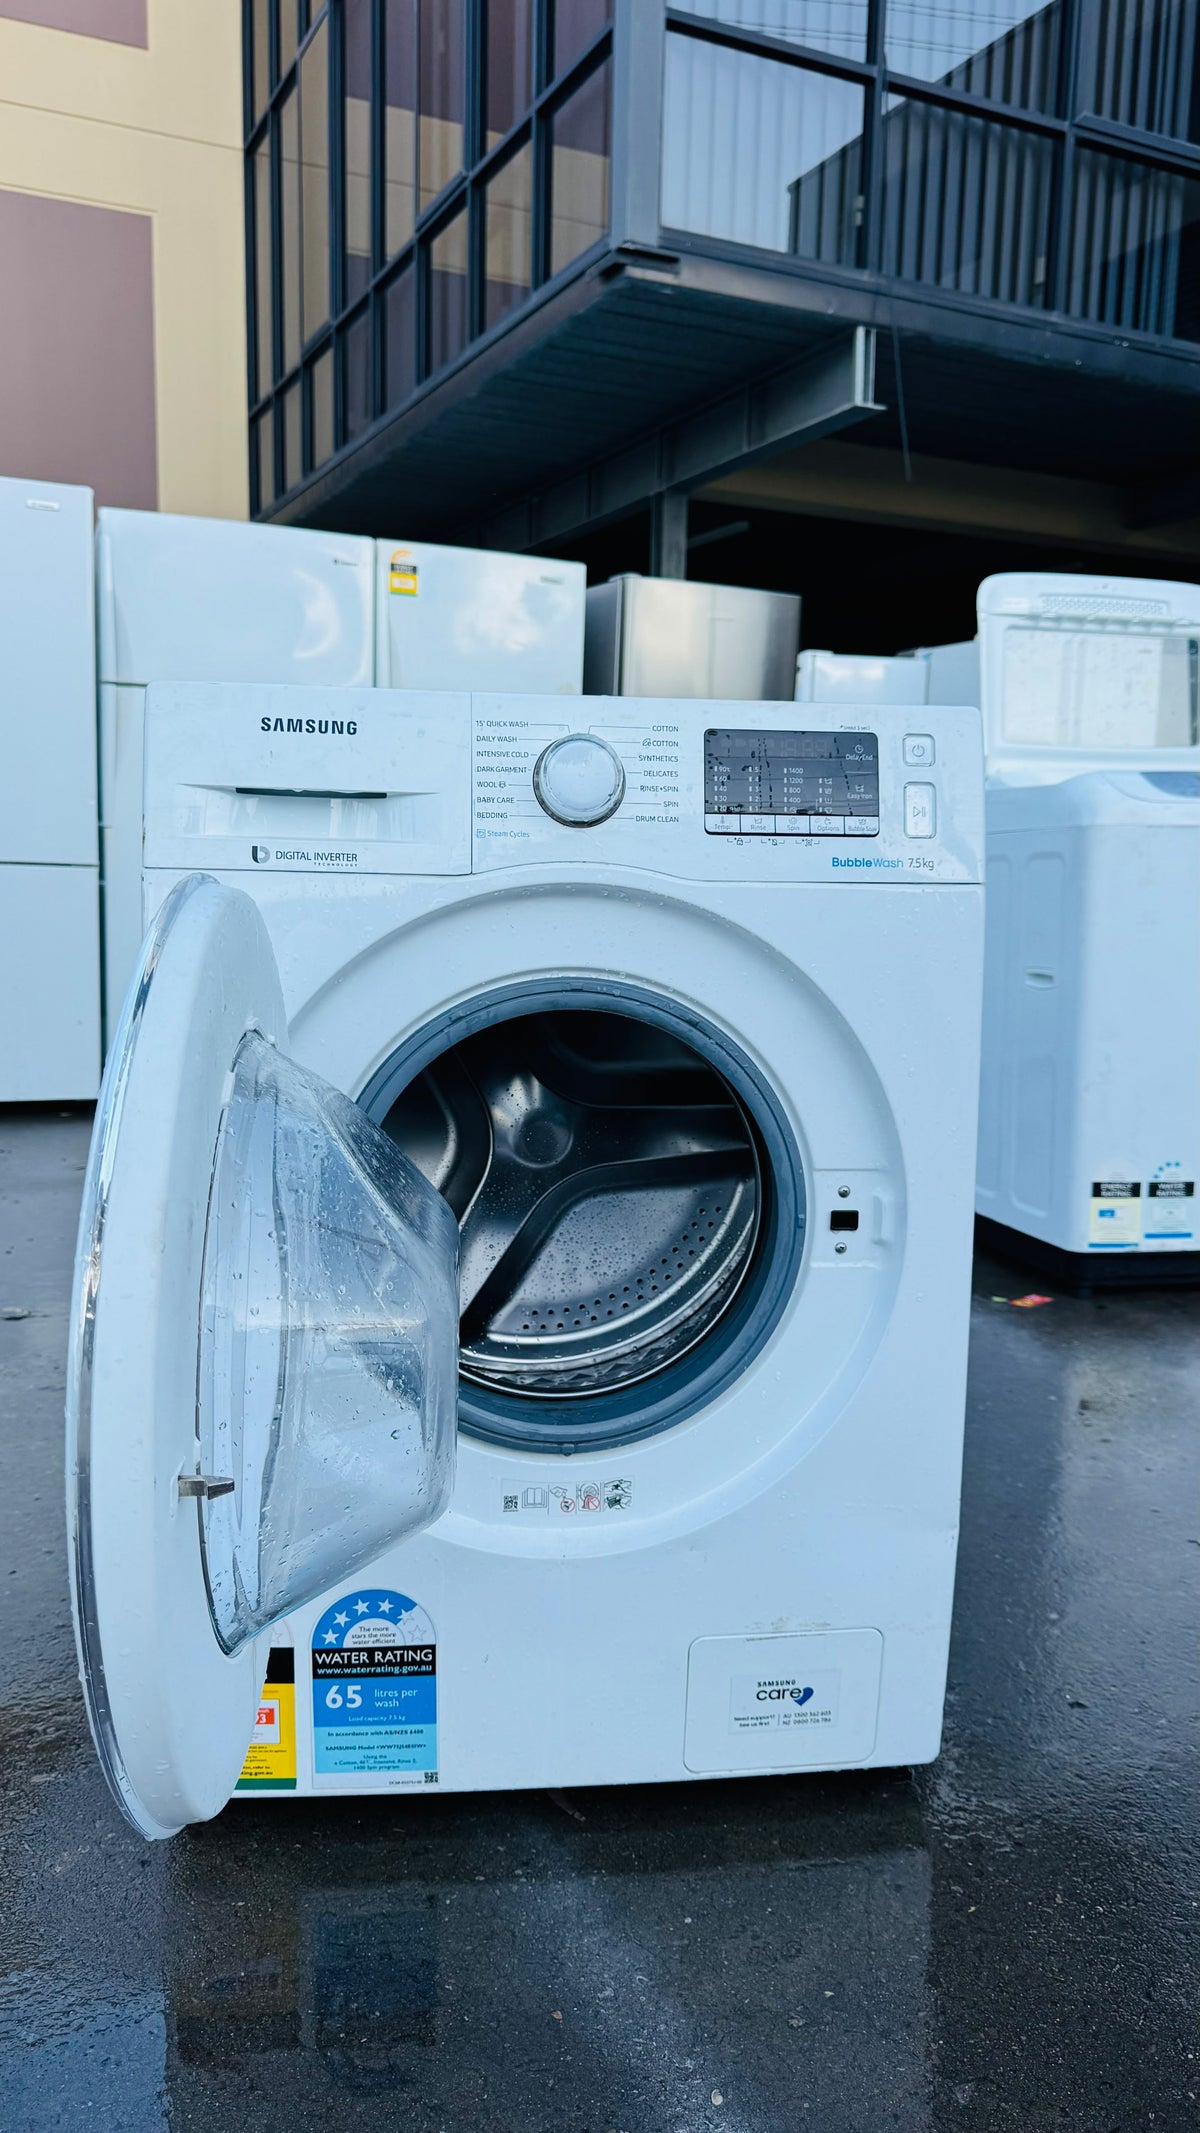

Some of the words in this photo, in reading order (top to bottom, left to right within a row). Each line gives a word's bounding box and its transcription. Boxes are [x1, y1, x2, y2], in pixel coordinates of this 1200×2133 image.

[261, 717, 357, 735] SAMSUNG
[486, 720, 507, 728] QUICK
[476, 735, 496, 743] DAILY
[643, 770, 679, 778] DELICATES
[477, 796, 495, 804] BABY
[817, 825, 840, 833] Options
[487, 830, 508, 838] Steam
[509, 830, 530, 839] Cycles
[275, 851, 311, 861] DIGITAL
[314, 852, 358, 862] INVERTER
[315, 1652, 369, 1664] WATER
[374, 1649, 432, 1663] RATING
[317, 1664, 432, 1675] www.waterrating.gov.au
[757, 1679, 796, 1687] SAMSUNG
[325, 1685, 362, 1709] 65
[374, 1688, 398, 1697] litres
[401, 1689, 418, 1699] per
[756, 1688, 802, 1701] care
[374, 1698, 399, 1707] wash
